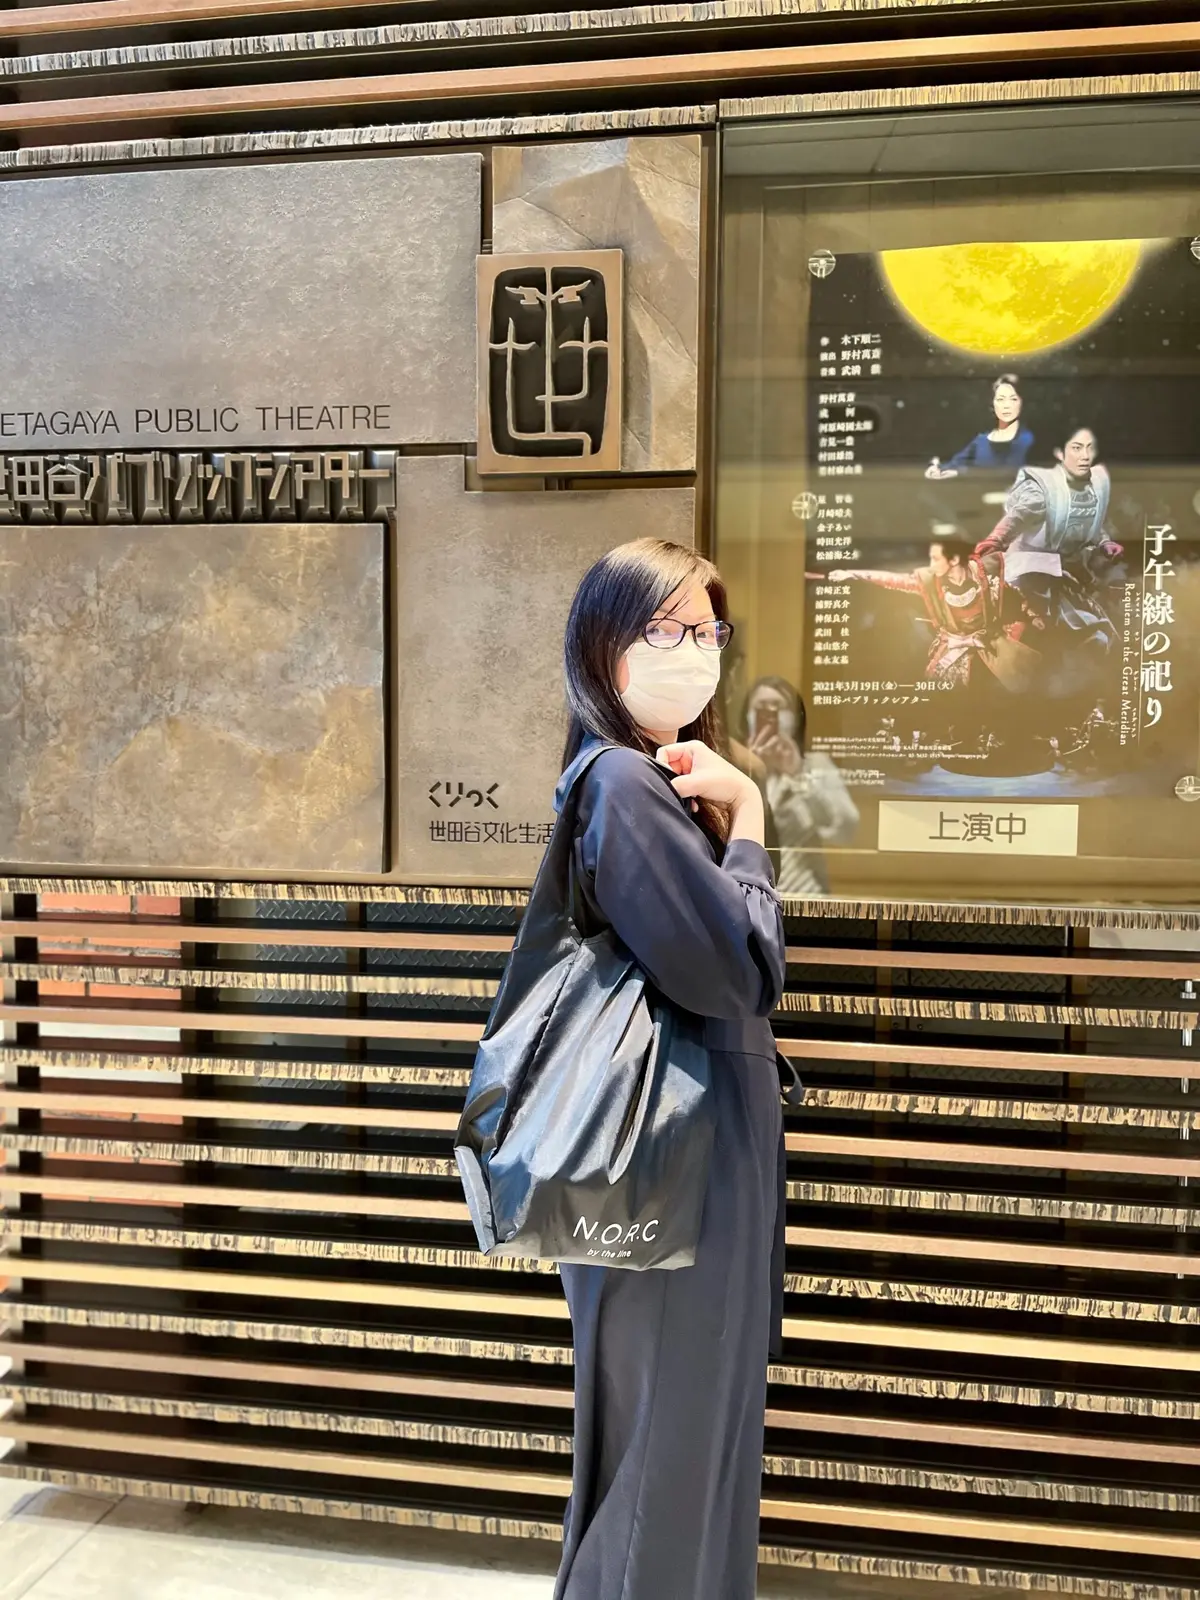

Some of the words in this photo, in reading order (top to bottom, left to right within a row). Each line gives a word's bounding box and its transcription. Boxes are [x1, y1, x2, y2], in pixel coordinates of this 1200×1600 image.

[135, 407, 239, 433] PUBLIC
[255, 404, 392, 431] THEATRE
[1122, 583, 1135, 626] Requiem
[1123, 630, 1130, 643] on
[1140, 523, 1177, 728] 子午線の祀り
[1122, 646, 1133, 663] the
[1121, 666, 1133, 695] Great
[813, 695, 930, 706] 世田谷パブリックシアター
[1119, 699, 1132, 745] Meridian
[428, 781, 499, 809] くりっく
[928, 811, 1026, 844] 上演中
[587, 1248, 600, 1257] by
[601, 1249, 615, 1258] the
[617, 1250, 632, 1258] line
